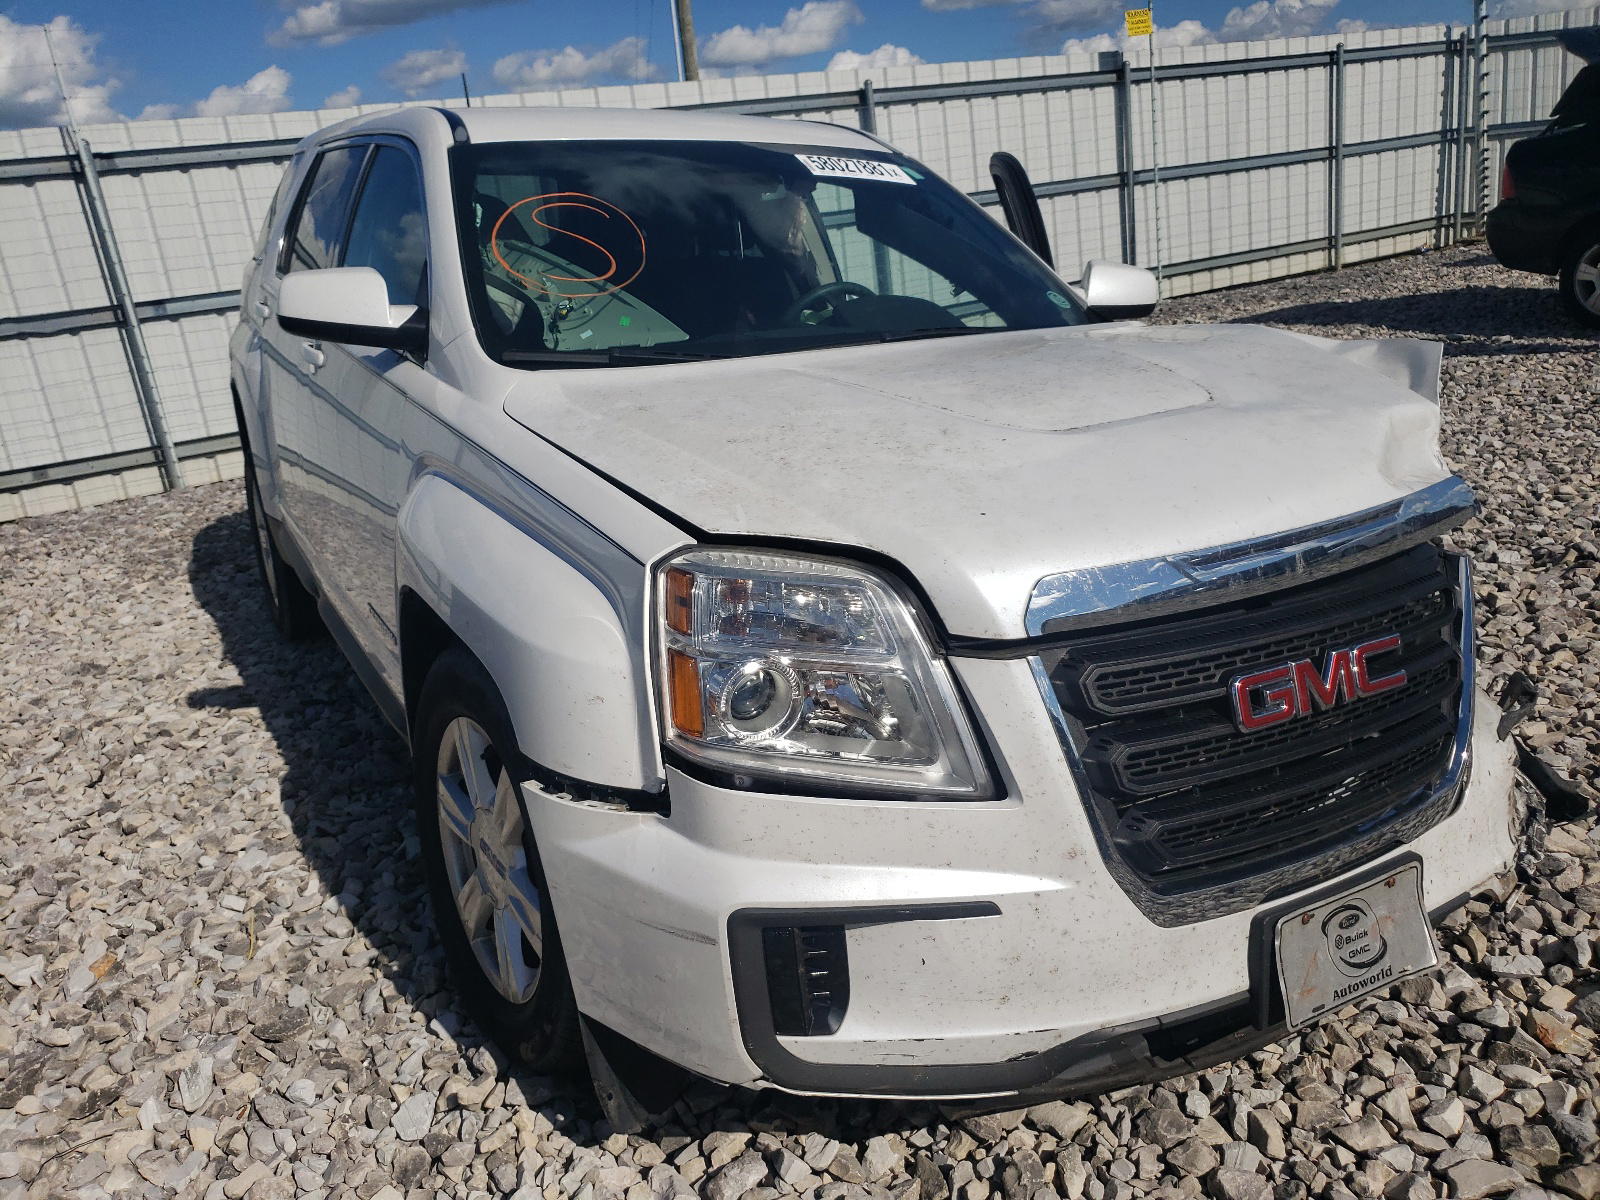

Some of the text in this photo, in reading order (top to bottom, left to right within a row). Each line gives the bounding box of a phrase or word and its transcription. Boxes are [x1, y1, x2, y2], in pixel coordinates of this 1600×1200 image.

[1230, 633, 1407, 733] GMC
[1345, 929, 1368, 945] Buick
[1348, 943, 1370, 959] GMC
[1333, 964, 1393, 1001] Autoworld
